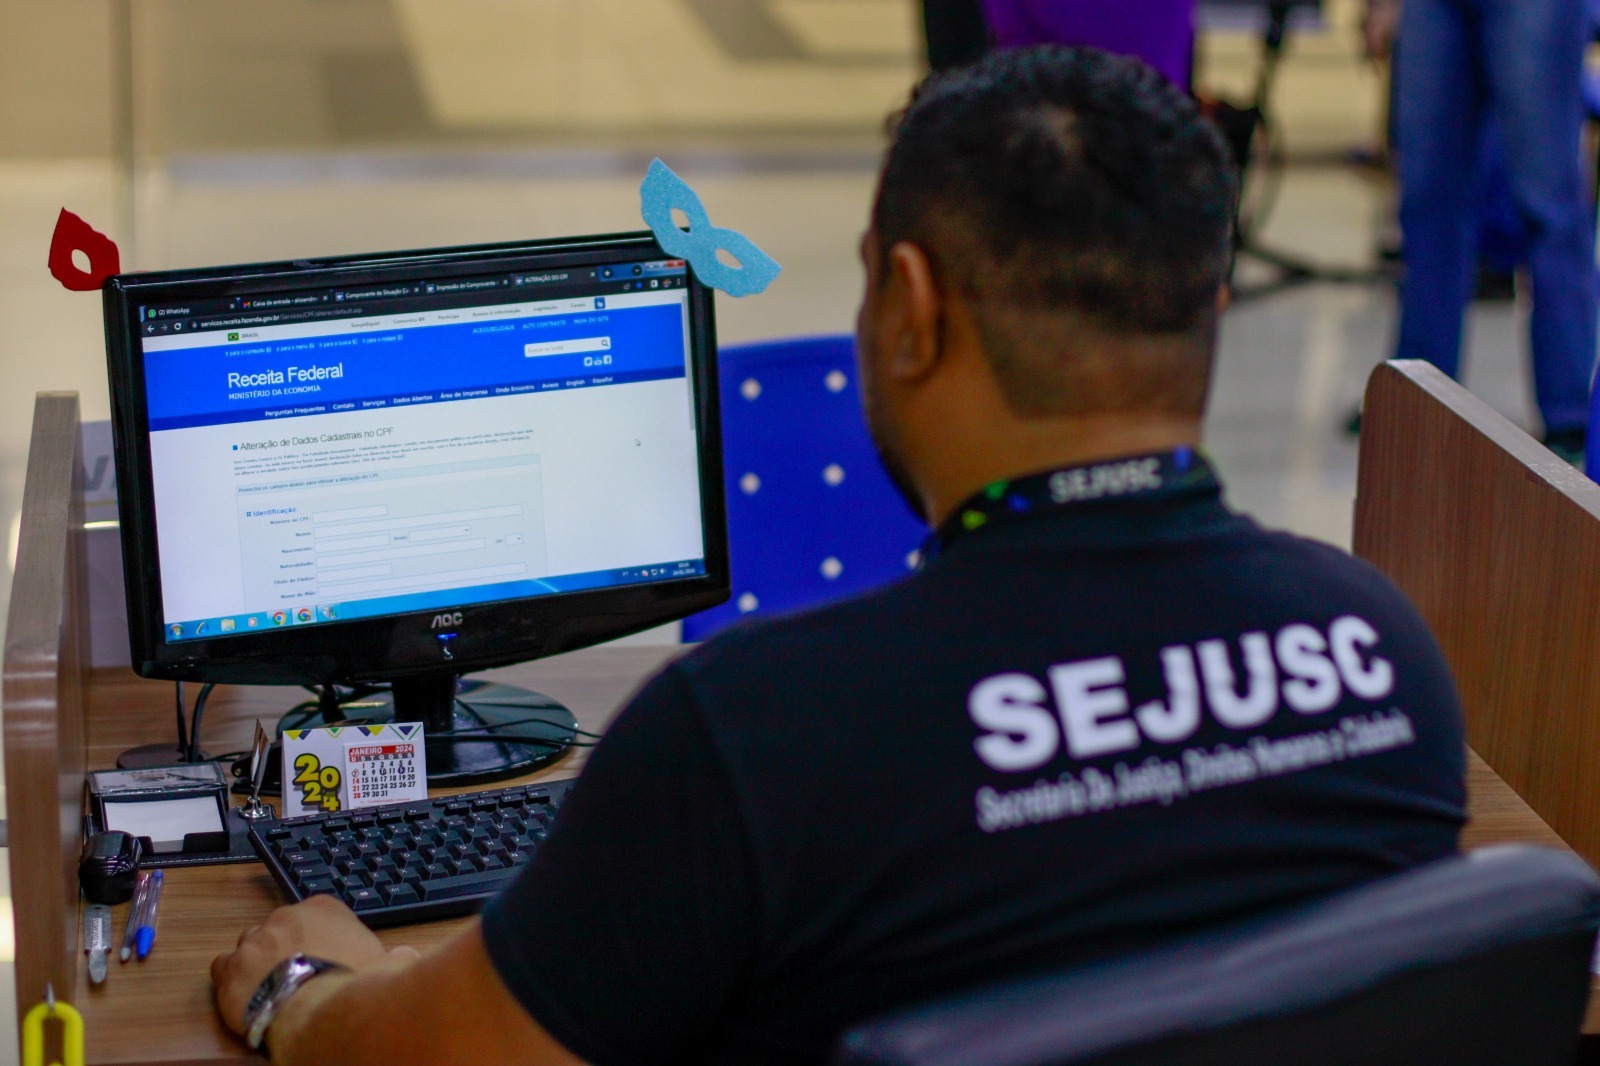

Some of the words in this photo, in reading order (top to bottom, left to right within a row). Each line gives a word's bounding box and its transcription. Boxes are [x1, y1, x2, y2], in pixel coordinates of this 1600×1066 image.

[166, 307, 190, 316] WhatsApp
[228, 370, 284, 389] Receita
[288, 362, 344, 382] Federal
[592, 376, 613, 385] Español
[495, 386, 510, 394] Onde
[511, 384, 535, 393] Encontro
[566, 379, 585, 388] English
[228, 389, 271, 400] MINISTÉRIO
[272, 388, 283, 396] DA
[284, 384, 321, 395] ECONOMIA
[440, 391, 454, 399] Área
[454, 390, 462, 398] de
[463, 388, 488, 398] Imprensa
[362, 399, 386, 408] Serviços
[393, 396, 411, 404] Dados
[411, 394, 433, 402] Abertos
[265, 408, 293, 418] Perguntas
[294, 405, 326, 415] Frequentes
[332, 402, 355, 410] Contato
[240, 440, 278, 451] Alteração
[280, 438, 290, 447] de
[292, 435, 318, 446] Dados
[320, 431, 362, 443] Cadastrais
[364, 430, 374, 438] no
[376, 427, 394, 437] CPF
[1048, 456, 1163, 504] SEJUSC
[253, 507, 297, 517] Identificação
[431, 611, 463, 629] AOC
[966, 614, 1395, 772] SEJUSC
[350, 747, 383, 756] JANEIRO
[395, 745, 413, 753] 2024
